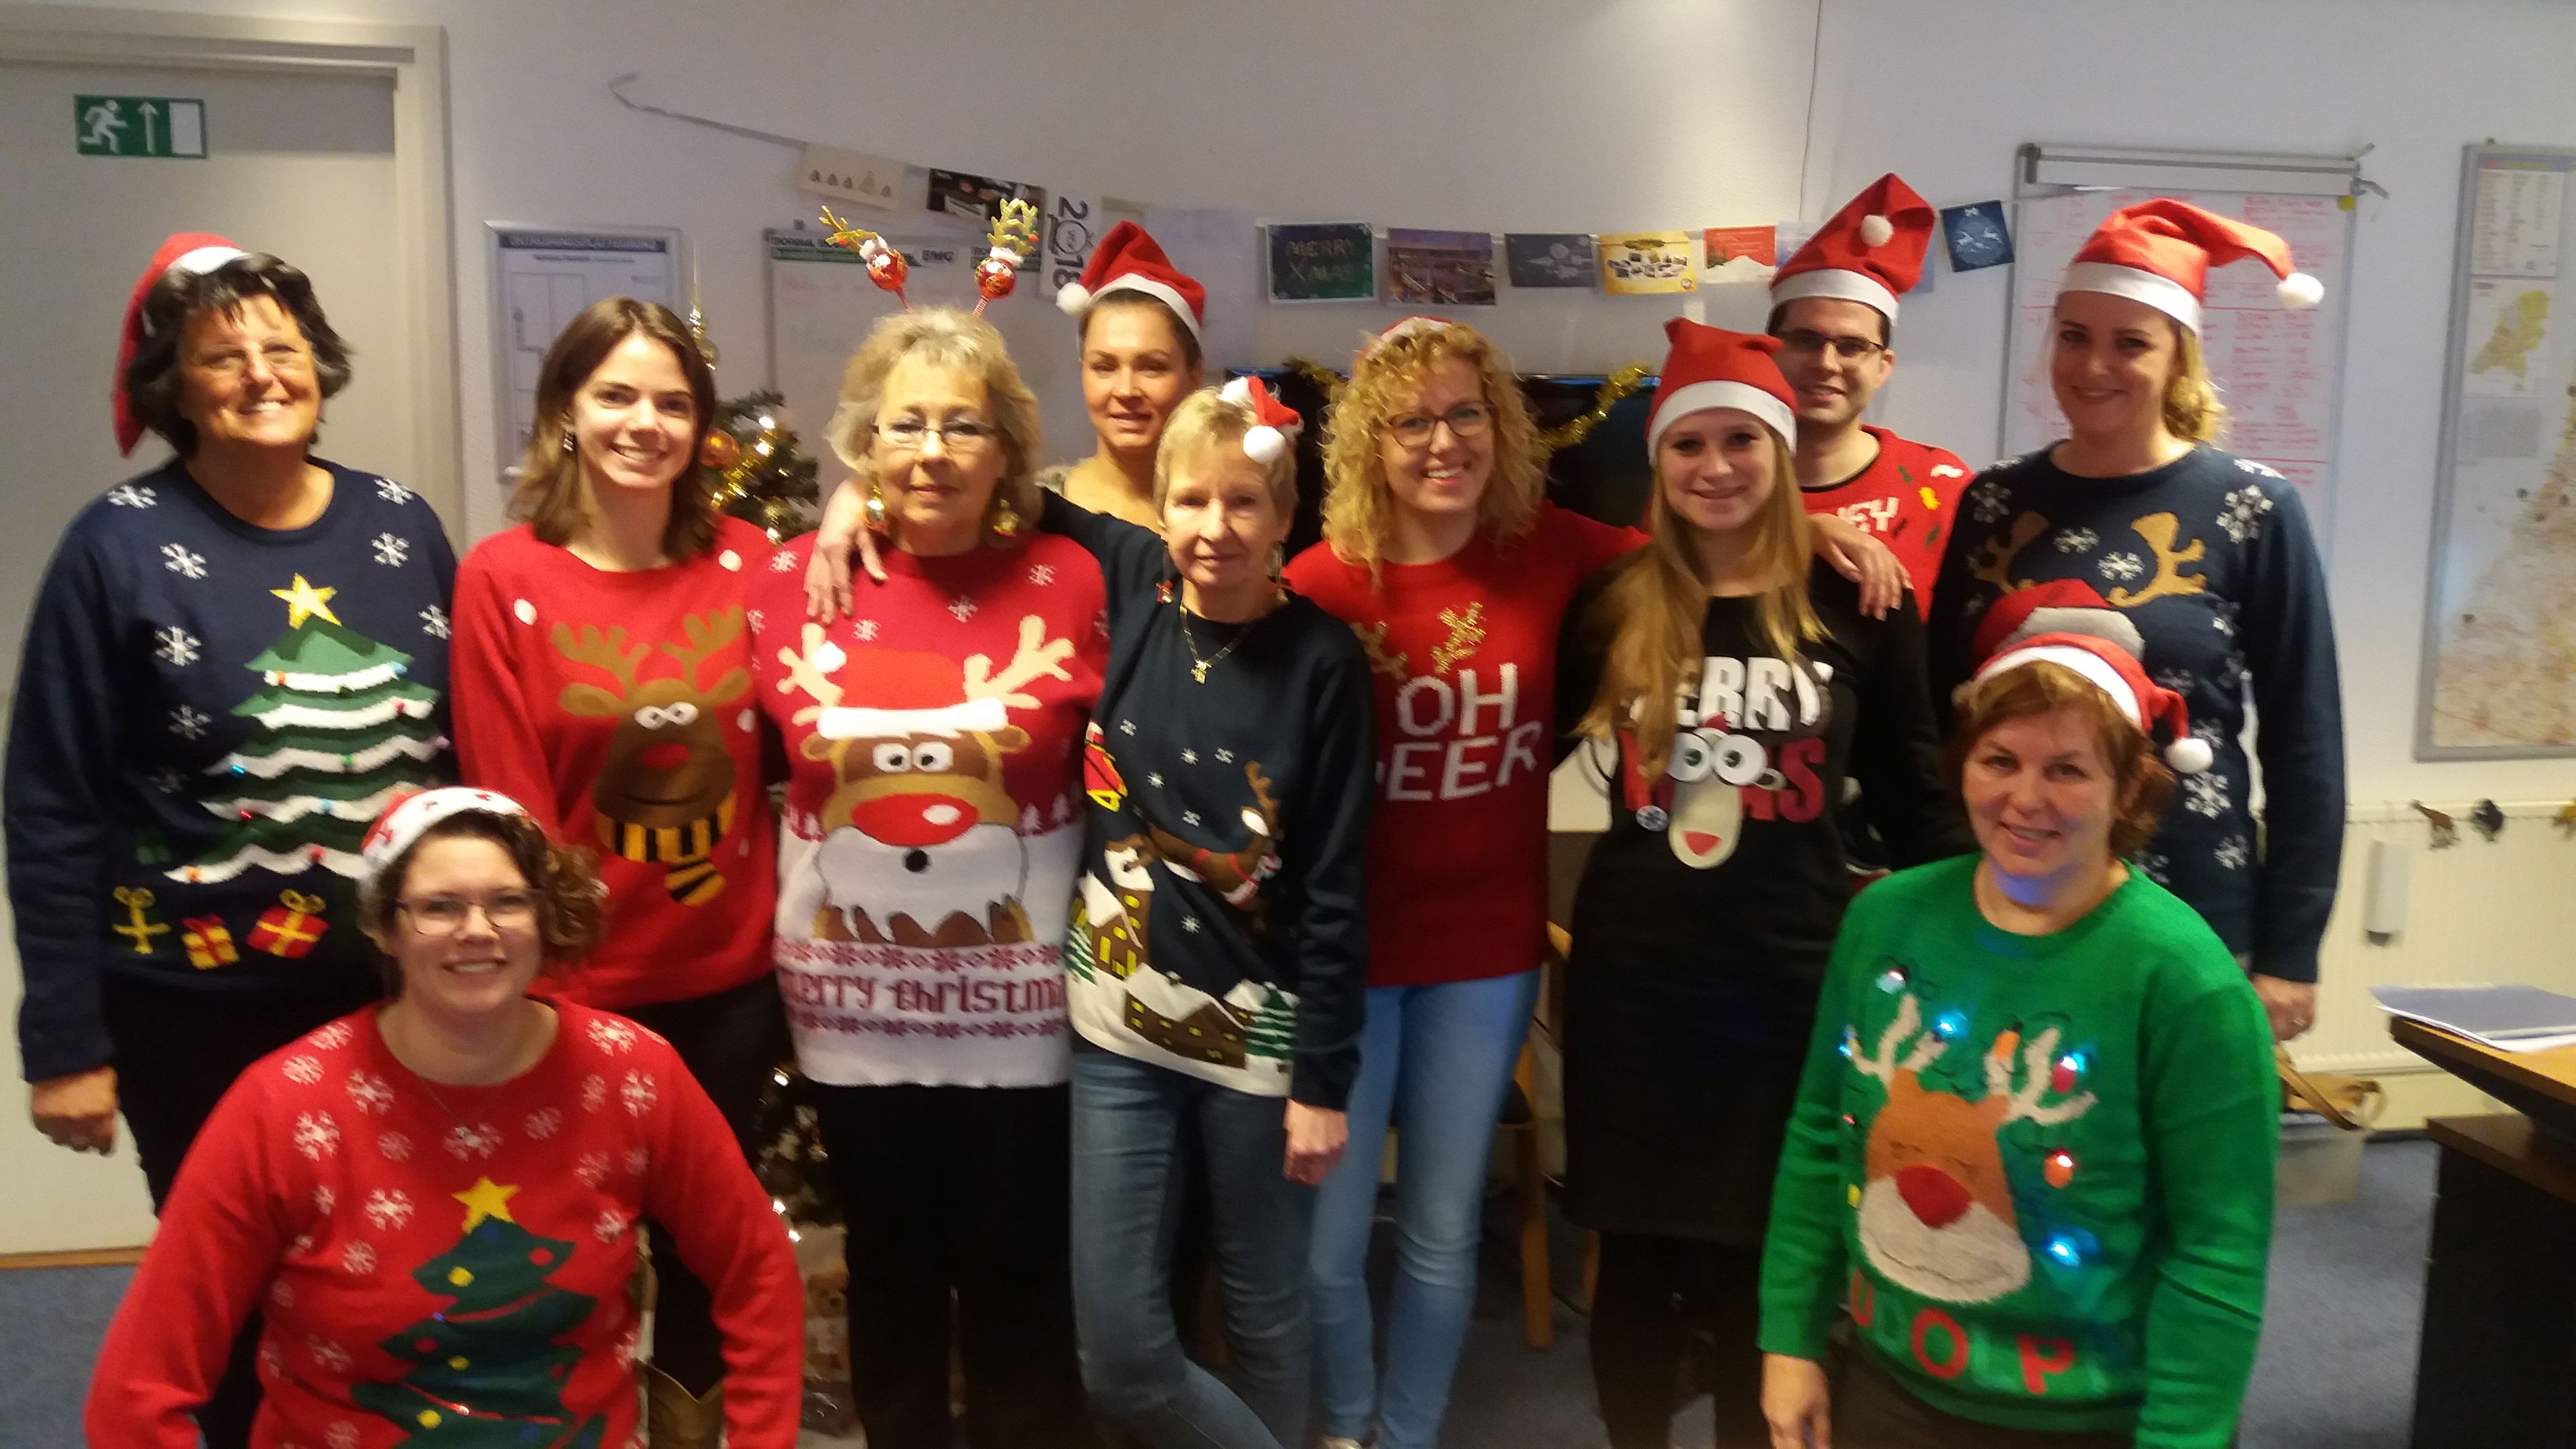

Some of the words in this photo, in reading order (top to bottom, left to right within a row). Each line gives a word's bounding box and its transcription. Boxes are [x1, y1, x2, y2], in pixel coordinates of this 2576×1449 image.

[1395, 663, 1518, 737] OH
[1629, 656, 1834, 731] ERRY
[1375, 720, 1543, 802] EER
